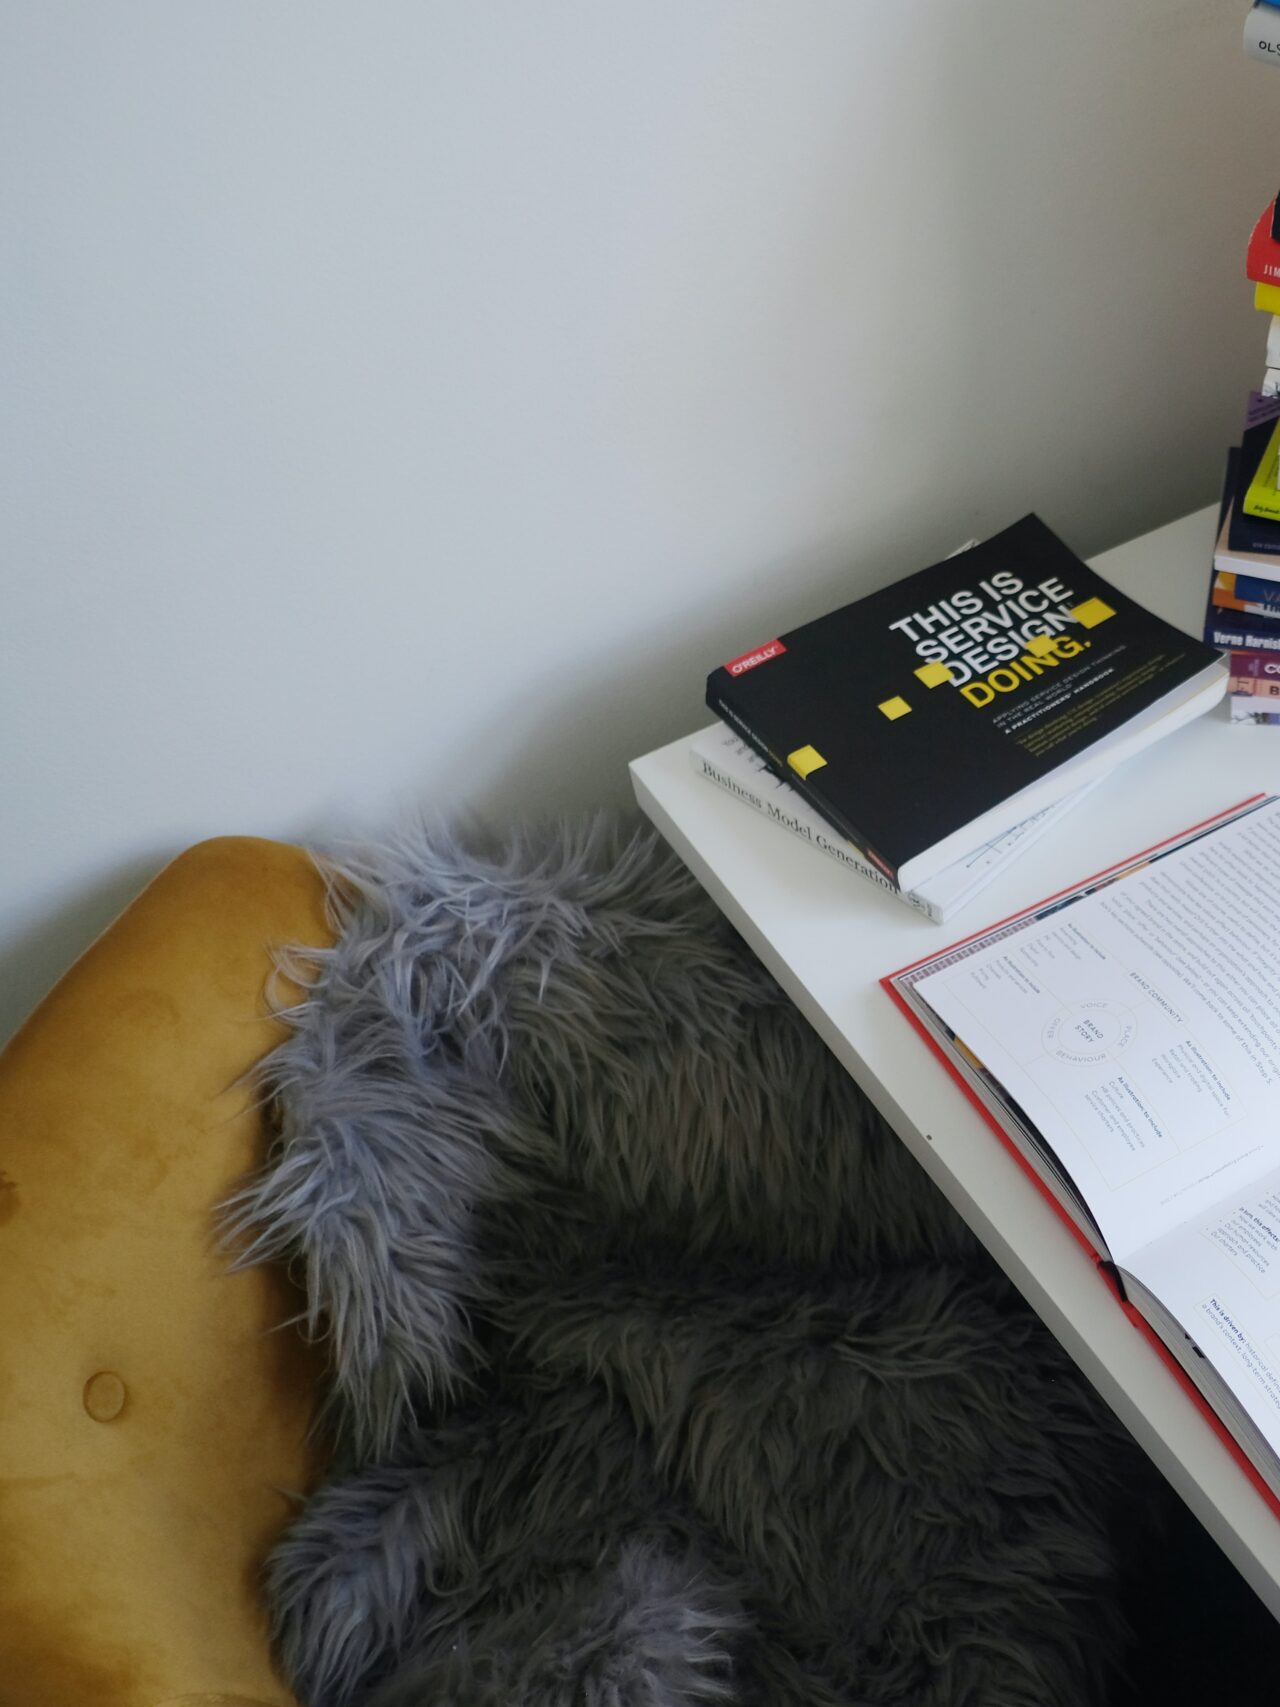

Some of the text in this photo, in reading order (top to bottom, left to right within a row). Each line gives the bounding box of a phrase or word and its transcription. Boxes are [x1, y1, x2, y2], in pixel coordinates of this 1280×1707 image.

[889, 571, 1025, 643] THIS IS
[915, 578, 1074, 665] SERVICE
[731, 645, 779, 674] O'REILLY
[946, 607, 1076, 688] DESIGN
[1213, 631, 1243, 646] Verne
[960, 639, 1092, 708] DOING.
[702, 759, 762, 811] Business
[767, 802, 812, 842] Model
[816, 838, 902, 896] Generation
[1079, 1001, 1108, 1010] VOICE
[1130, 971, 1183, 1025] BRAND COMMUNITY
[1074, 1024, 1093, 1044] STORY
[1083, 1018, 1103, 1039] BRAND
[1055, 1049, 1108, 1064] BEHAVIOUR
[1210, 1299, 1247, 1346] This is driven by:
